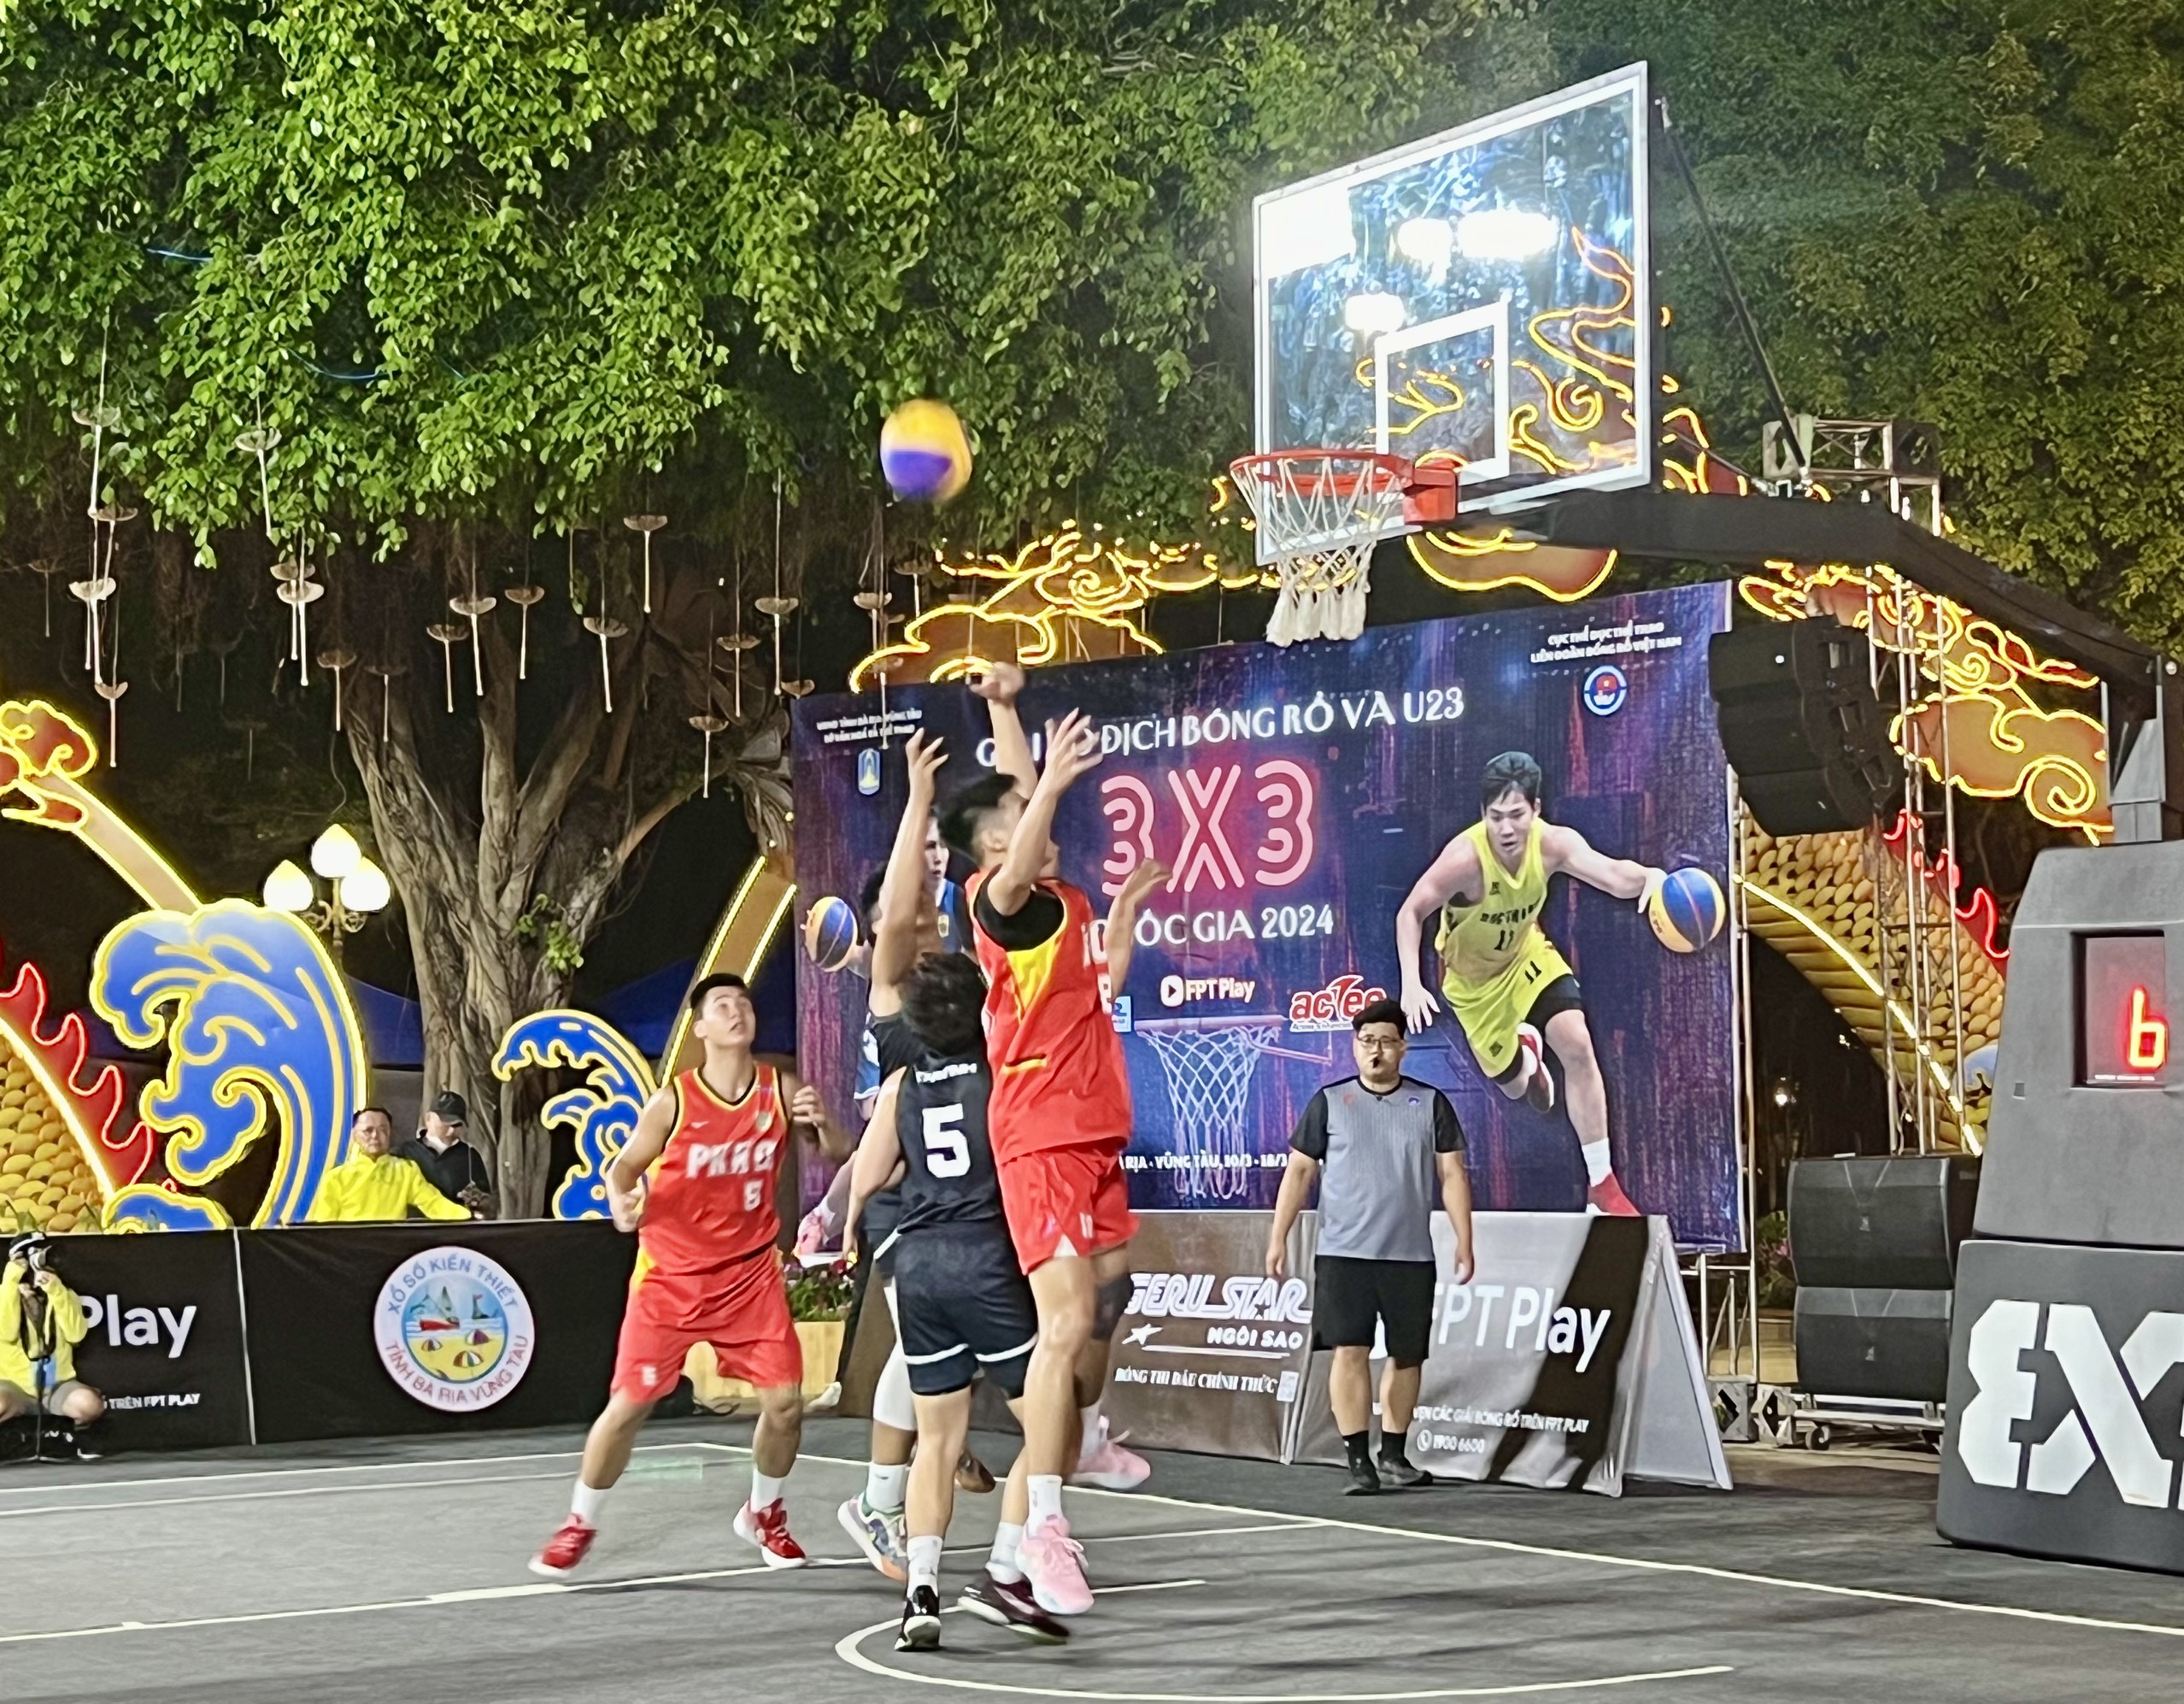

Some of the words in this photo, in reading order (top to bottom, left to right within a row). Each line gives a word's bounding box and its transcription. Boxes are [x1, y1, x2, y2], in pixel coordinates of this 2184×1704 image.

[1182, 708, 1276, 747] BÓNG
[1403, 686, 1465, 723] U23
[1193, 909, 1255, 943] GIA
[1261, 904, 1334, 939] 2024
[1185, 979, 1218, 1002] FPT
[1219, 978, 1256, 1003] Play
[921, 1102, 972, 1178] 5
[1221, 1277, 1313, 1325] STAR
[79, 1294, 197, 1359] Play
[1206, 1325, 1259, 1348] NGÔI
[1260, 1330, 1304, 1350] SAO
[1506, 1286, 1612, 1373] Play
[168, 1393, 201, 1407] PLAY
